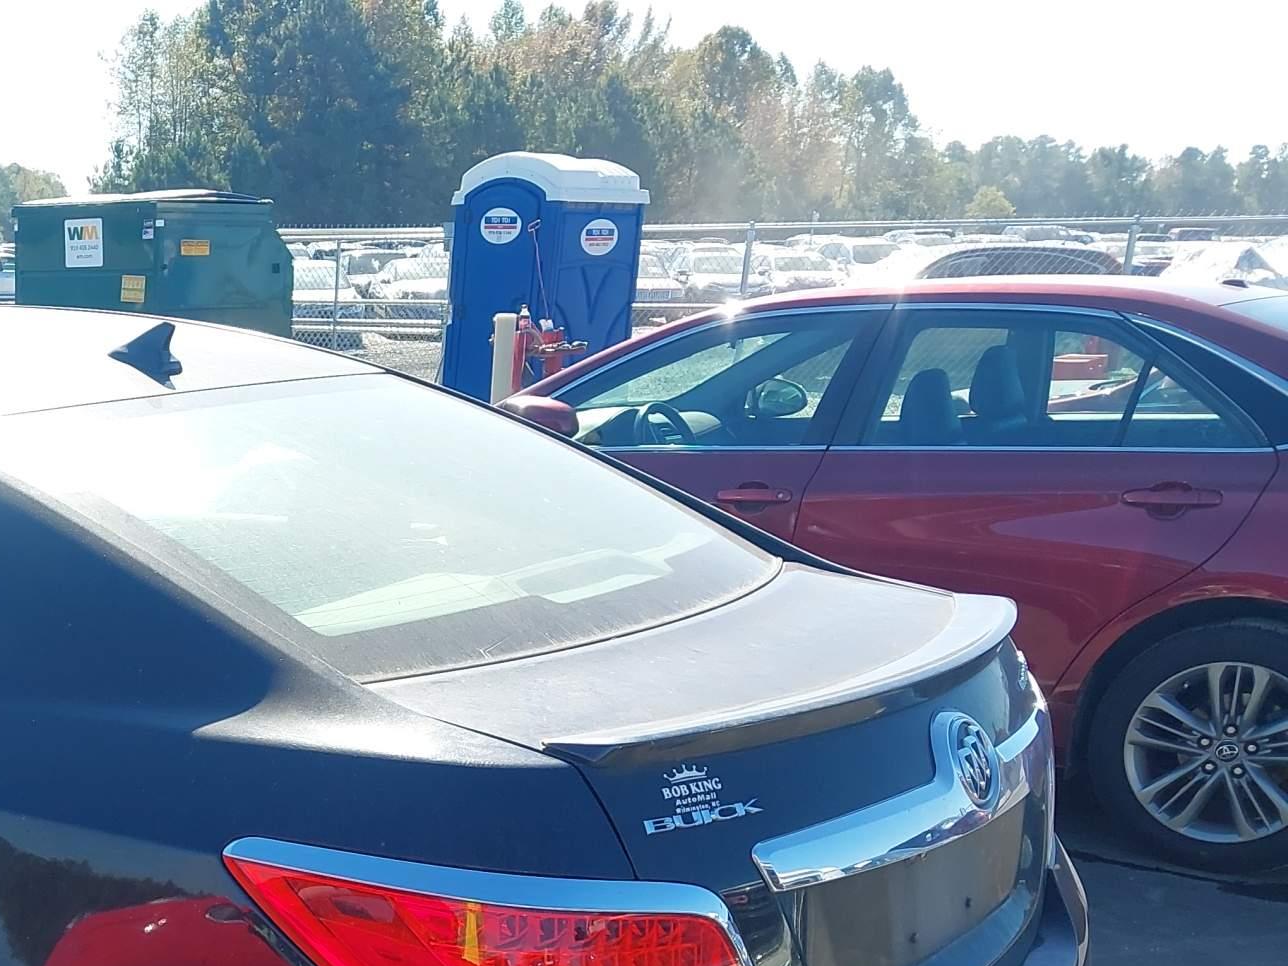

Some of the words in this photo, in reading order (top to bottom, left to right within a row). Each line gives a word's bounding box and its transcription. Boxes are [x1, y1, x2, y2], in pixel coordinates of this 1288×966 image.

[67, 225, 99, 241] WM
[661, 784, 689, 799] BOB
[689, 778, 722, 794] KING
[675, 791, 717, 806] AutoMall
[643, 798, 764, 835] BUICK
